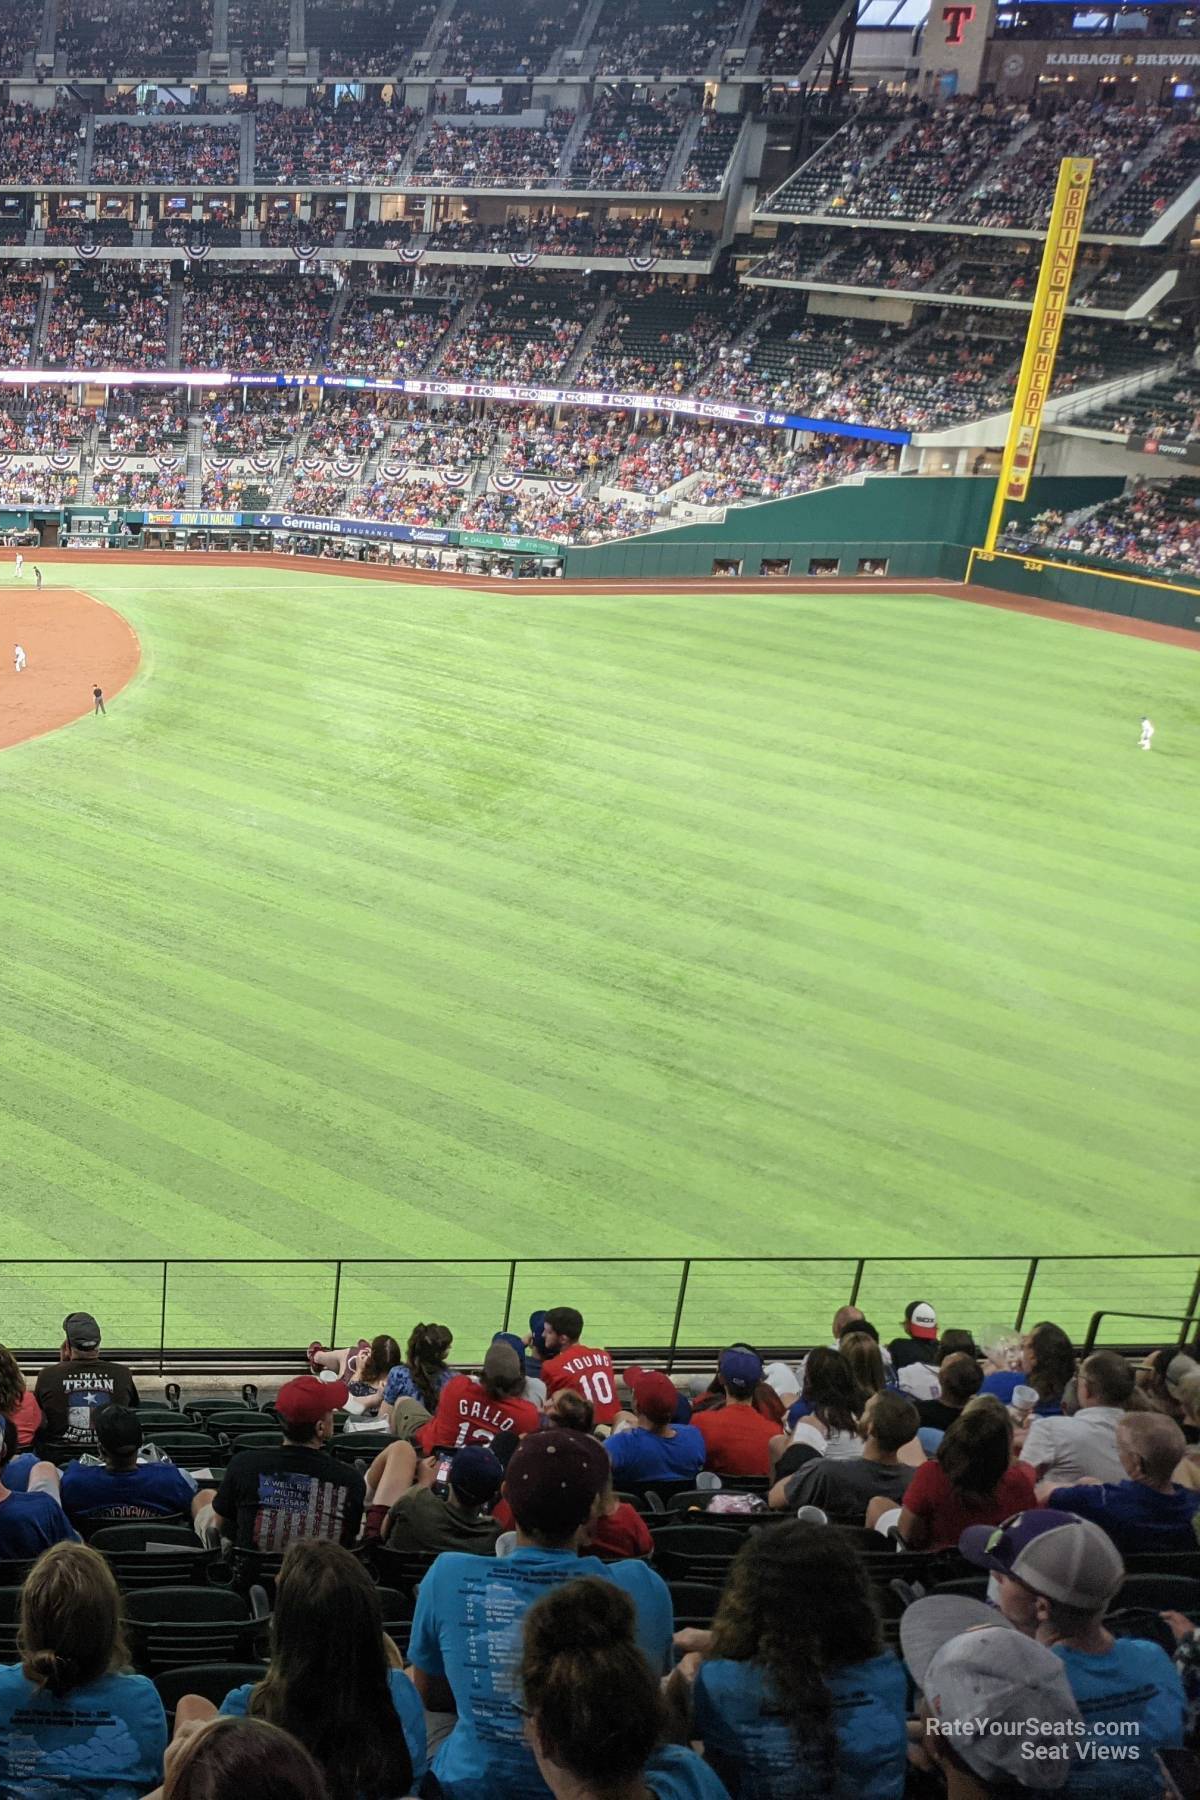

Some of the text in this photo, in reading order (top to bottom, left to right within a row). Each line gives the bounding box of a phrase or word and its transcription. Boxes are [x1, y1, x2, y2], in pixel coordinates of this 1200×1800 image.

[943, 5, 976, 45] T
[1046, 53, 1121, 65] KARBACH
[1024, 189, 1083, 426] BRING THE HEAT
[1158, 445, 1187, 455] TOYOTA
[180, 513, 198, 525] HOW
[200, 513, 208, 525] TO
[210, 513, 235, 525] NACHO
[281, 515, 341, 532] Germania
[342, 527, 394, 538] INSURANCE
[470, 537, 494, 545] DALLAS
[1024, 561, 1043, 572] 334
[563, 1353, 610, 1375] YOUNG
[63, 1379, 114, 1392] TEXAN
[579, 1371, 613, 1404] 10
[459, 1399, 514, 1432] GALLO
[272, 1480, 292, 1489] WELL
